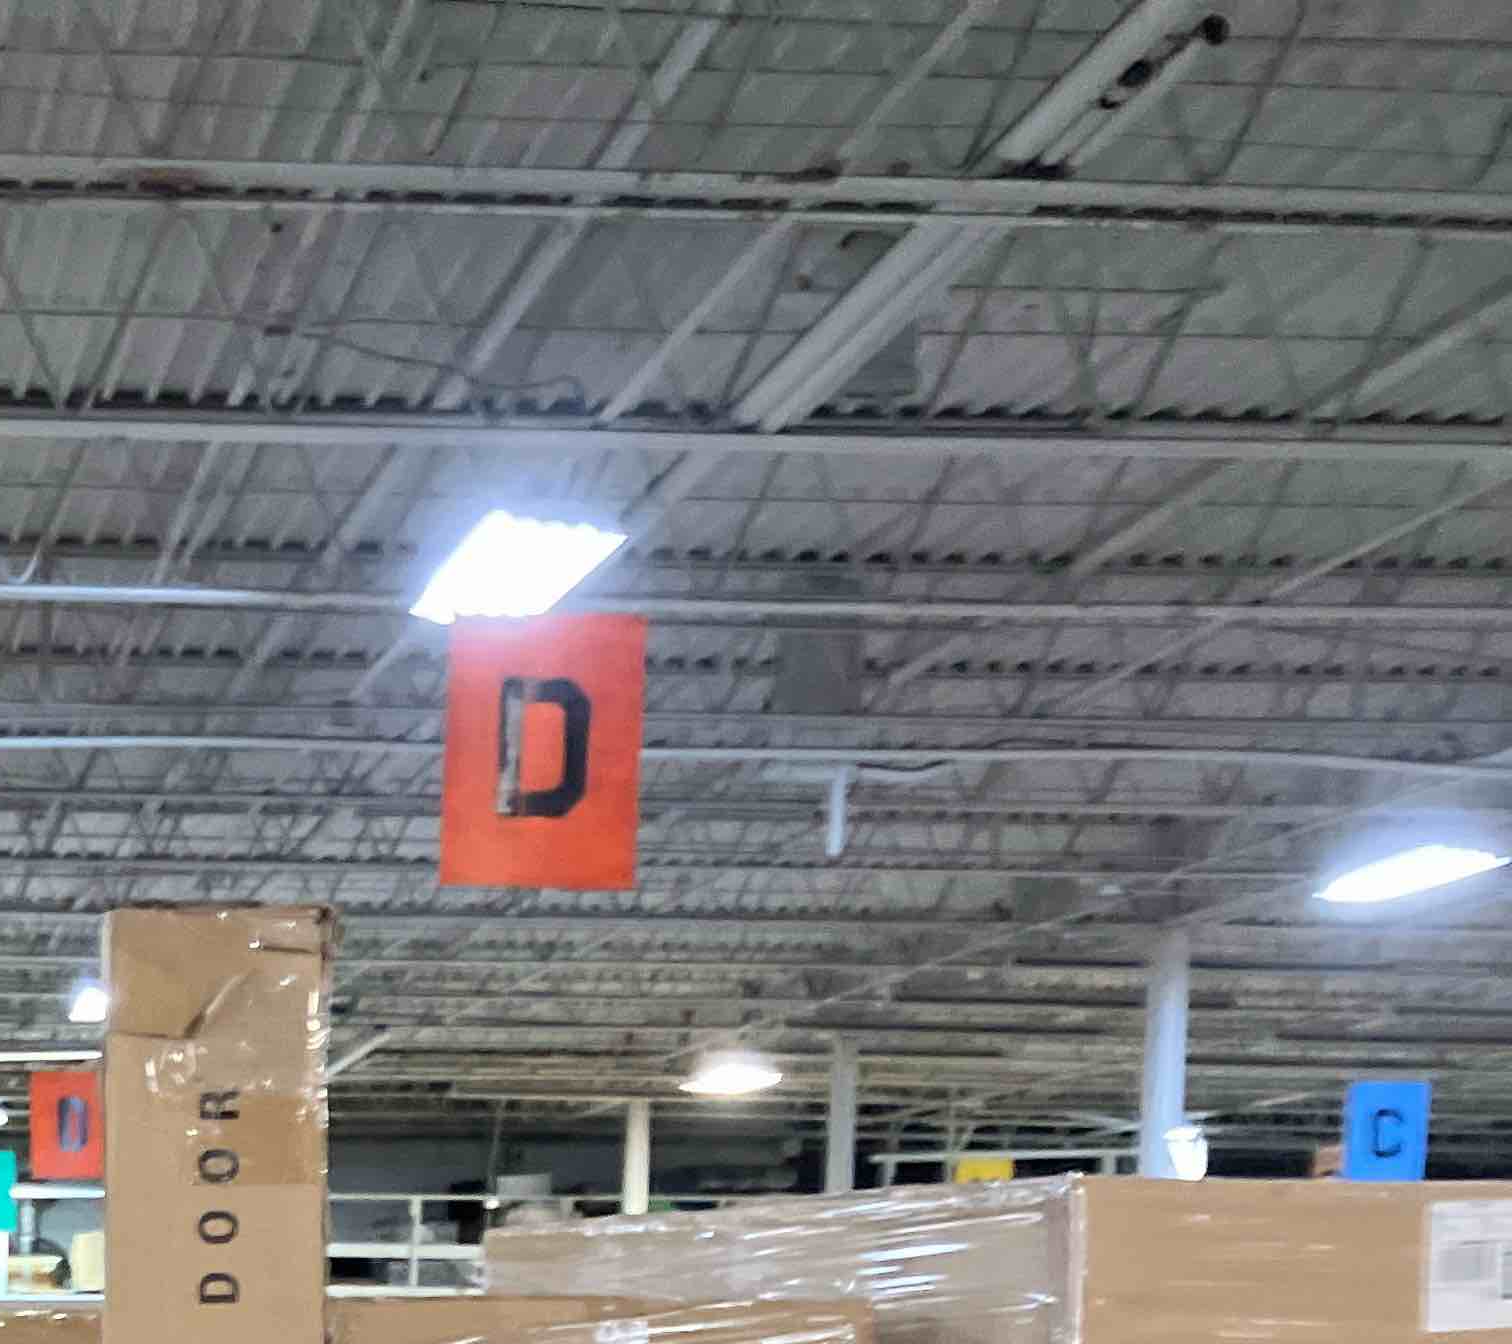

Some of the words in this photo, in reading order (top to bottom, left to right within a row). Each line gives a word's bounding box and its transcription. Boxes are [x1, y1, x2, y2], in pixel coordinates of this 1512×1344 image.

[496, 676, 591, 818] D
[197, 1090, 241, 1305] DOOR
[1372, 1109, 1404, 1158] C
